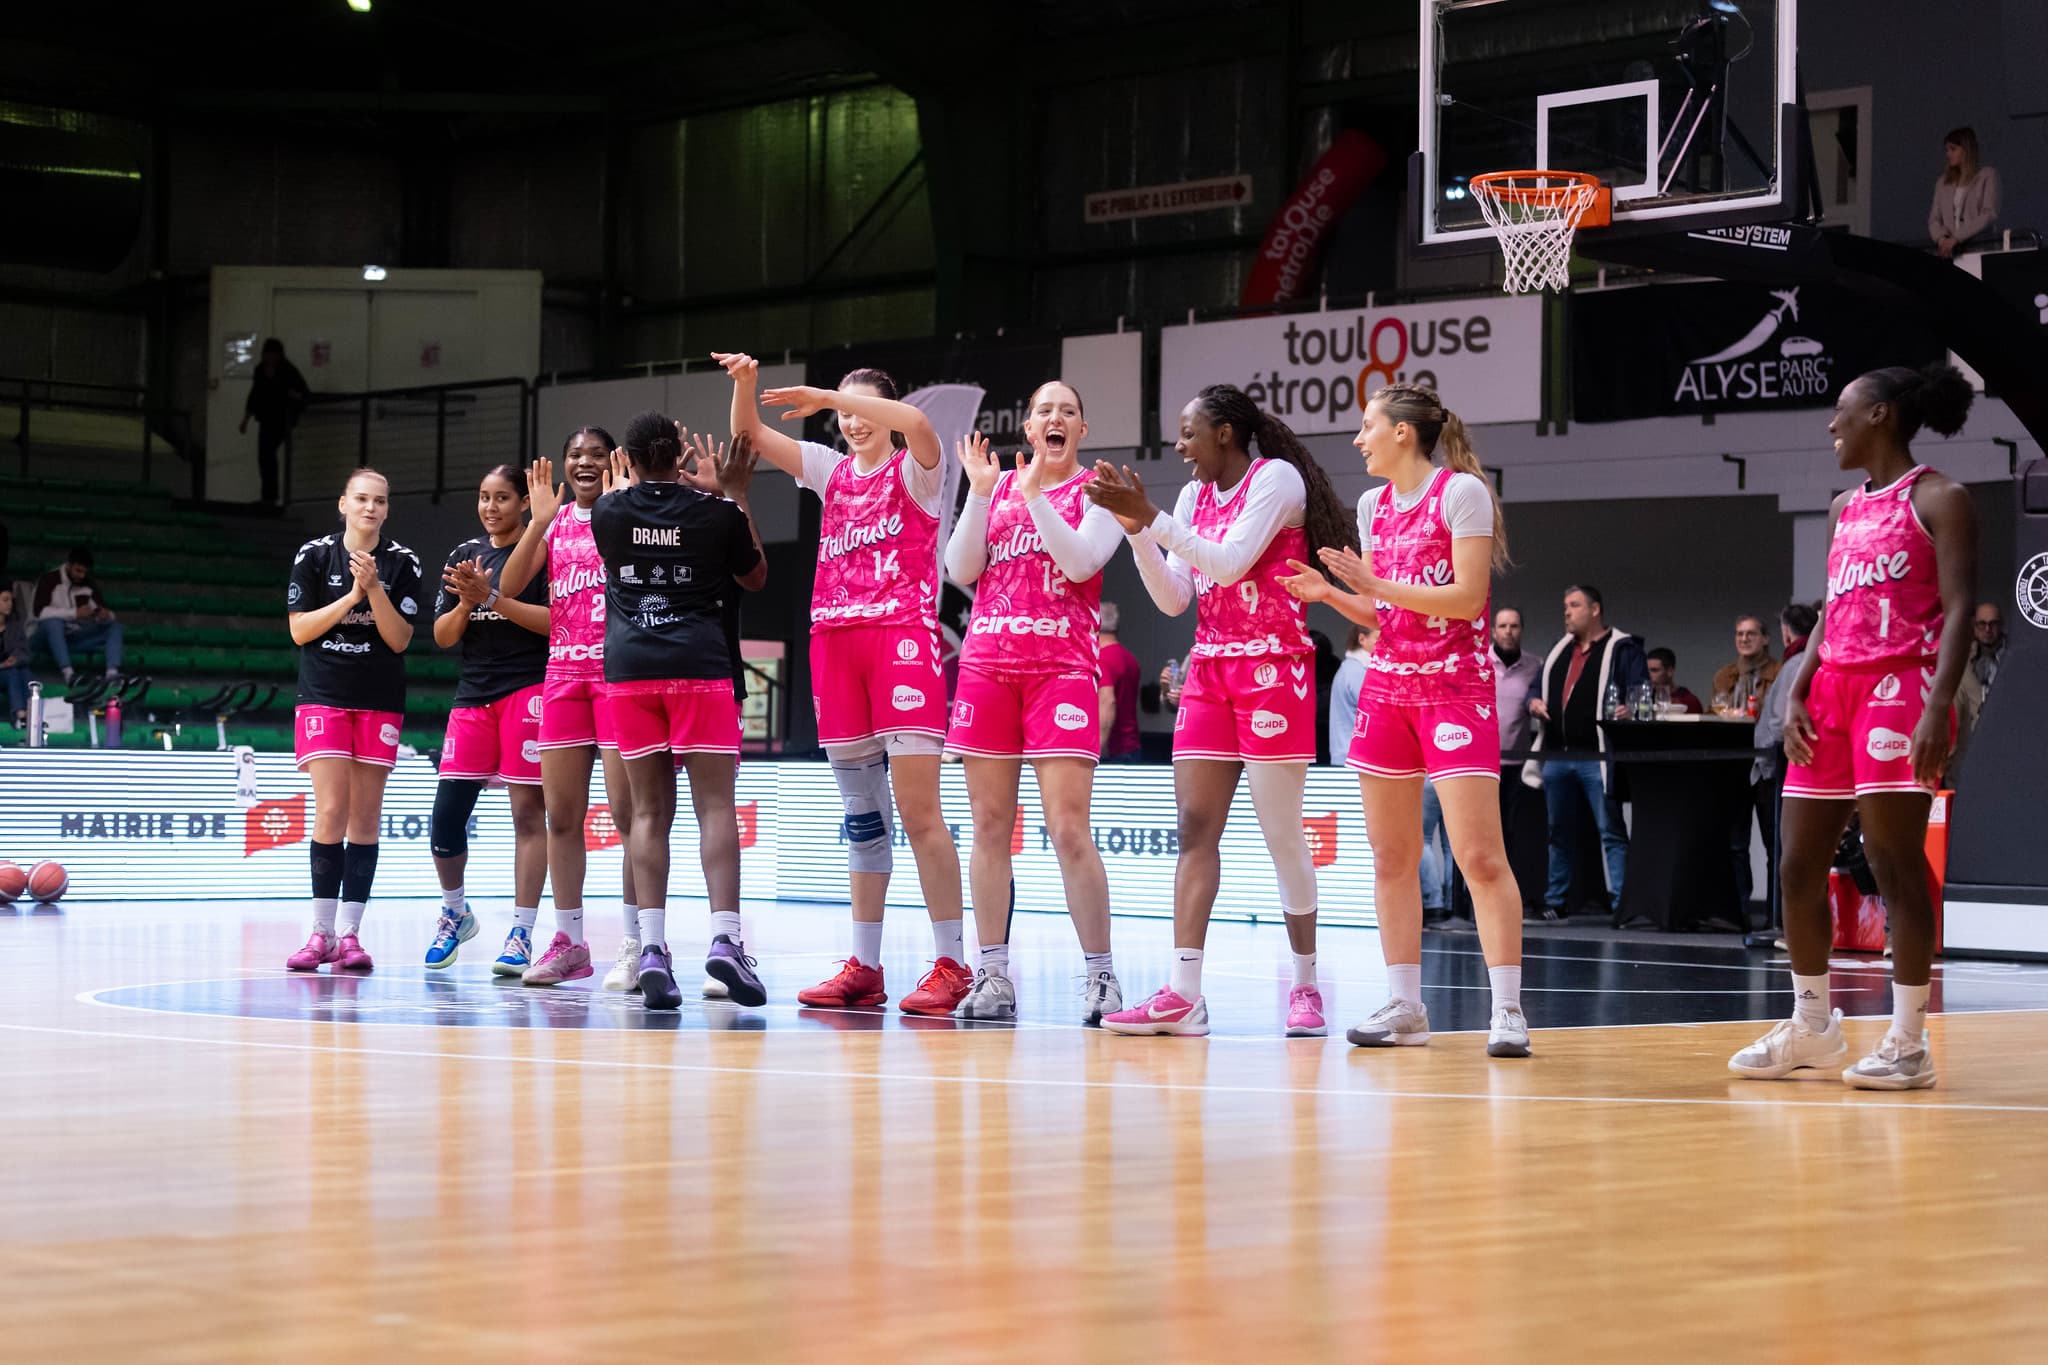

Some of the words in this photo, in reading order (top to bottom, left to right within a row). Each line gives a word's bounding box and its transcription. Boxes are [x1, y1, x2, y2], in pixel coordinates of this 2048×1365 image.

[1283, 315, 1492, 369] toulouse
[1779, 357, 1827, 379] PARC
[1674, 361, 1779, 402] ALYSE
[1781, 377, 1829, 397] AUTO
[632, 526, 681, 546] DRAMÉ
[819, 513, 904, 564] Toulouse
[872, 549, 900, 581] 14
[1042, 560, 1067, 597] 12
[591, 593, 606, 622] 2
[1240, 580, 1259, 615] 9
[469, 608, 509, 621] circ
[810, 598, 900, 623] circet
[1879, 598, 1890, 638] 1
[971, 609, 1071, 638] circet
[1425, 615, 1449, 636] 4
[321, 639, 371, 653] circet
[549, 639, 605, 661] circe
[894, 694, 923, 703] ICADE
[1057, 713, 1086, 722] ICADE
[1254, 720, 1285, 729] ICADE
[1437, 731, 1469, 744] ICADE
[1871, 740, 1907, 750] ICADE
[524, 748, 540, 756] ICA
[61, 812, 174, 838] MAIRIE
[188, 812, 226, 838] DE
[1039, 826, 1179, 856] TLOUSE
